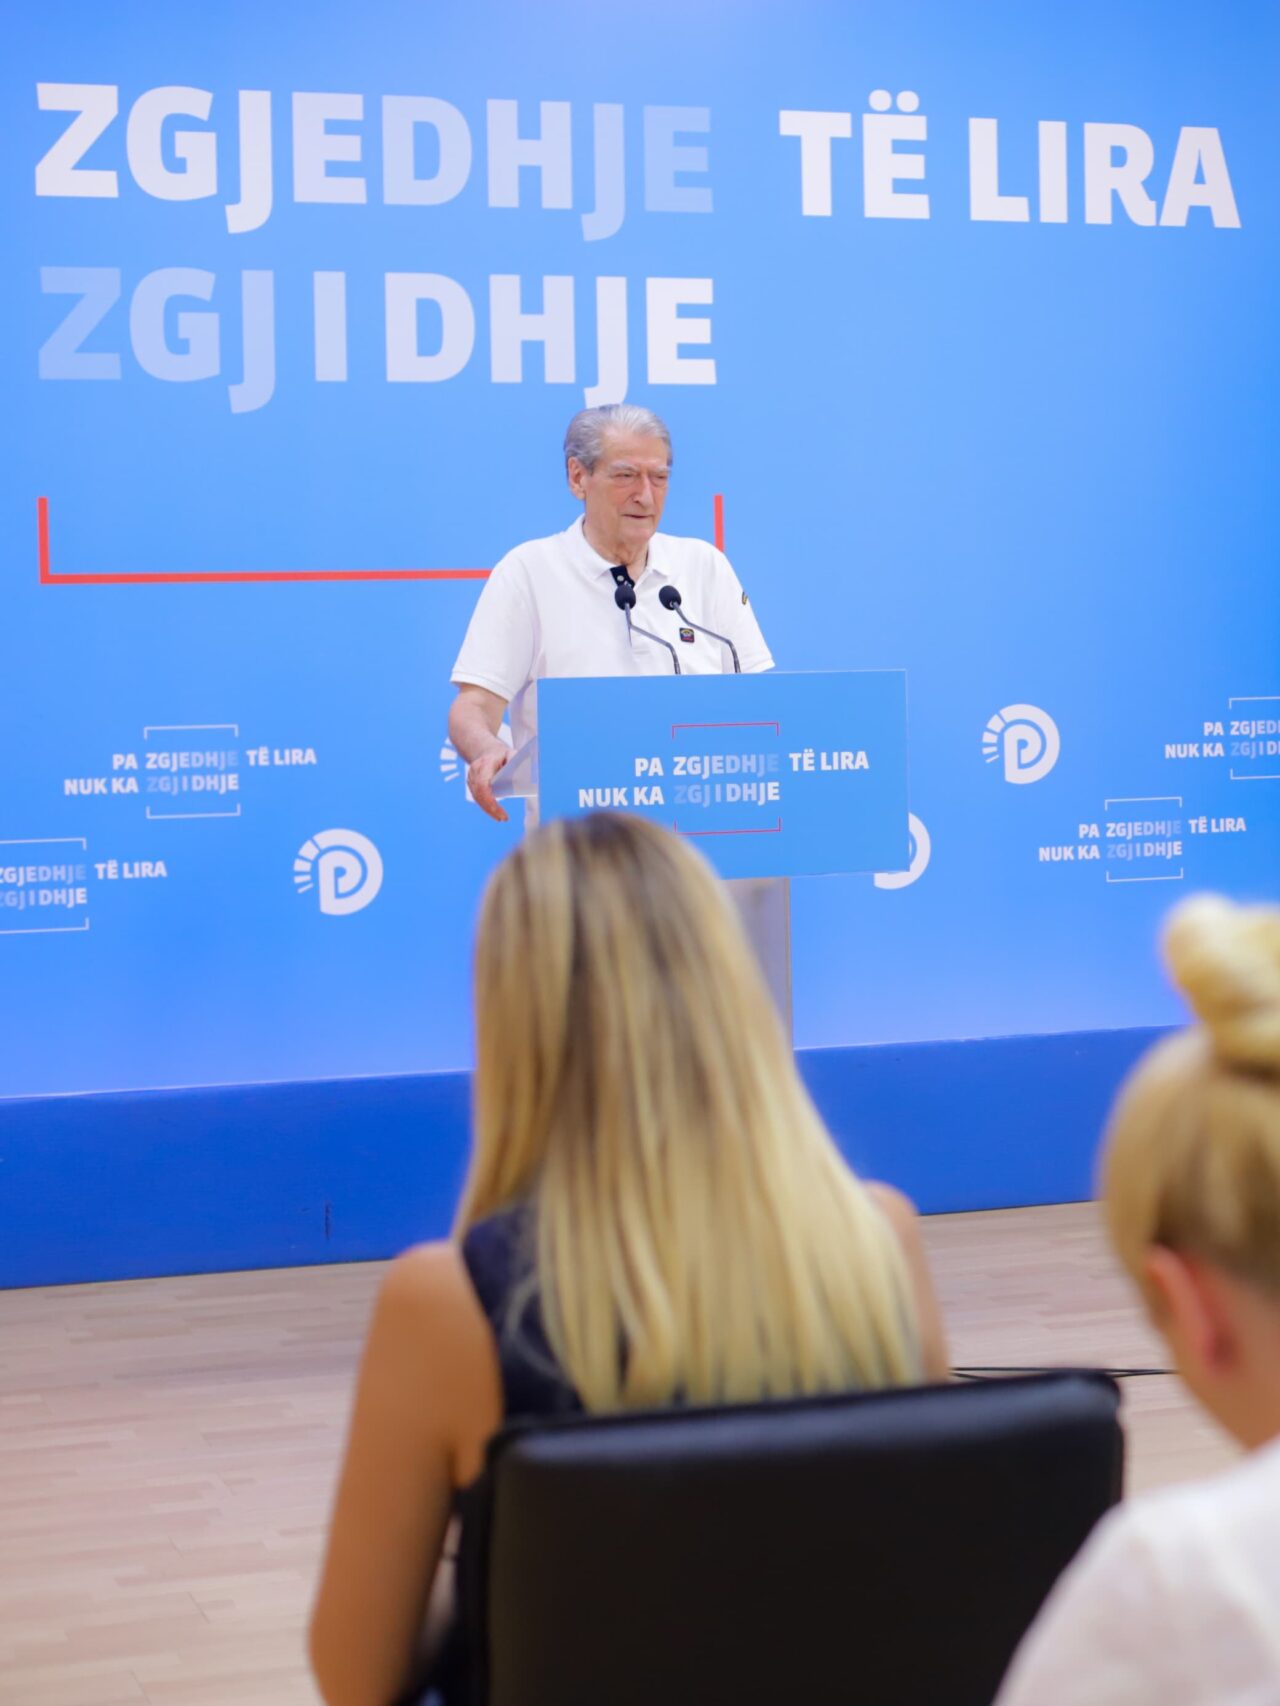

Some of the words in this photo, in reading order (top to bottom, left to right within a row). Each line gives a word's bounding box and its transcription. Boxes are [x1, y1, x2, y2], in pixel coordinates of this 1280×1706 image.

[34, 82, 714, 241] ZGJEDHJE
[779, 89, 930, 219] TË
[968, 117, 1242, 229] LIRA
[1203, 721, 1224, 736] PA
[112, 753, 138, 770] PA
[145, 751, 239, 772] ZGJEDHJE
[246, 746, 270, 766] TË
[274, 748, 317, 766] LIRA
[1165, 743, 1200, 759] NUK
[1203, 742, 1225, 758] KA
[635, 757, 664, 777] PA
[673, 754, 779, 779] ZGJEDHJE
[789, 748, 815, 771] TË
[820, 751, 870, 771] LIRA
[64, 778, 107, 796] NUK
[112, 777, 139, 794] KA
[579, 787, 628, 808] NUK
[634, 786, 664, 806] KA
[1079, 823, 1100, 839] PA
[1106, 820, 1182, 840] ZGJEDHJE
[1188, 816, 1208, 834] TË
[1211, 817, 1247, 833] LIRA
[1039, 846, 1075, 862] NUK
[1078, 844, 1100, 860] KA
[94, 859, 119, 880] TË
[123, 861, 168, 879] LIRA
